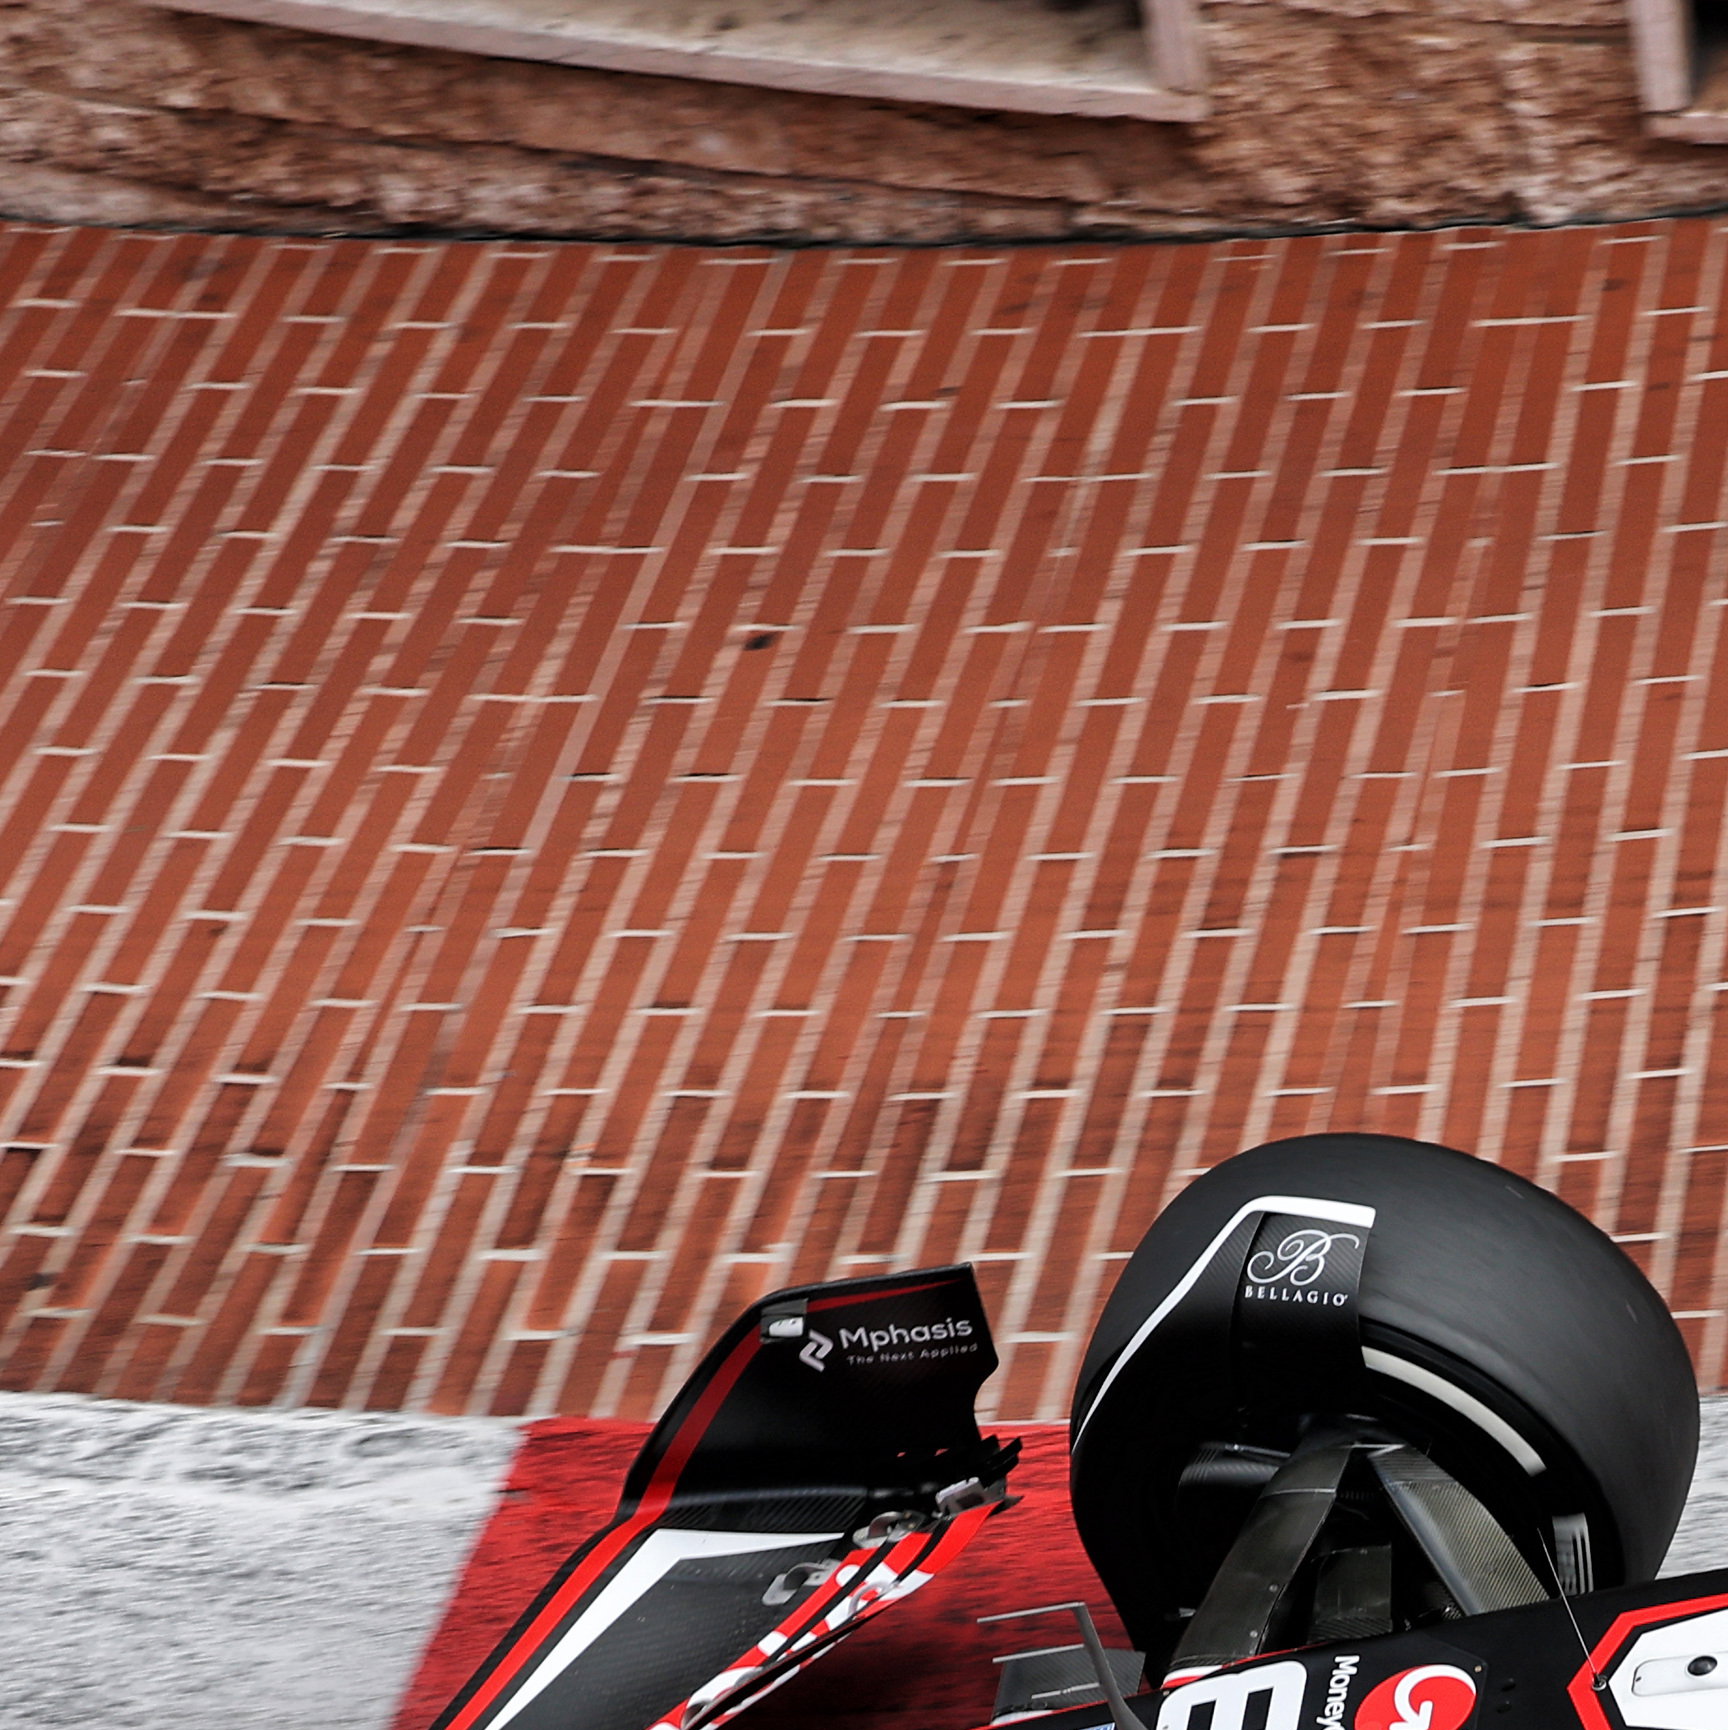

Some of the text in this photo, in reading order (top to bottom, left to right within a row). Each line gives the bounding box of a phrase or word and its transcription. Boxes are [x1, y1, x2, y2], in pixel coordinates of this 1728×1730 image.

[1244, 1285, 1348, 1307] BELLAGIO
[838, 1317, 973, 1353] Mphasis
[920, 1343, 978, 1359] Applied
